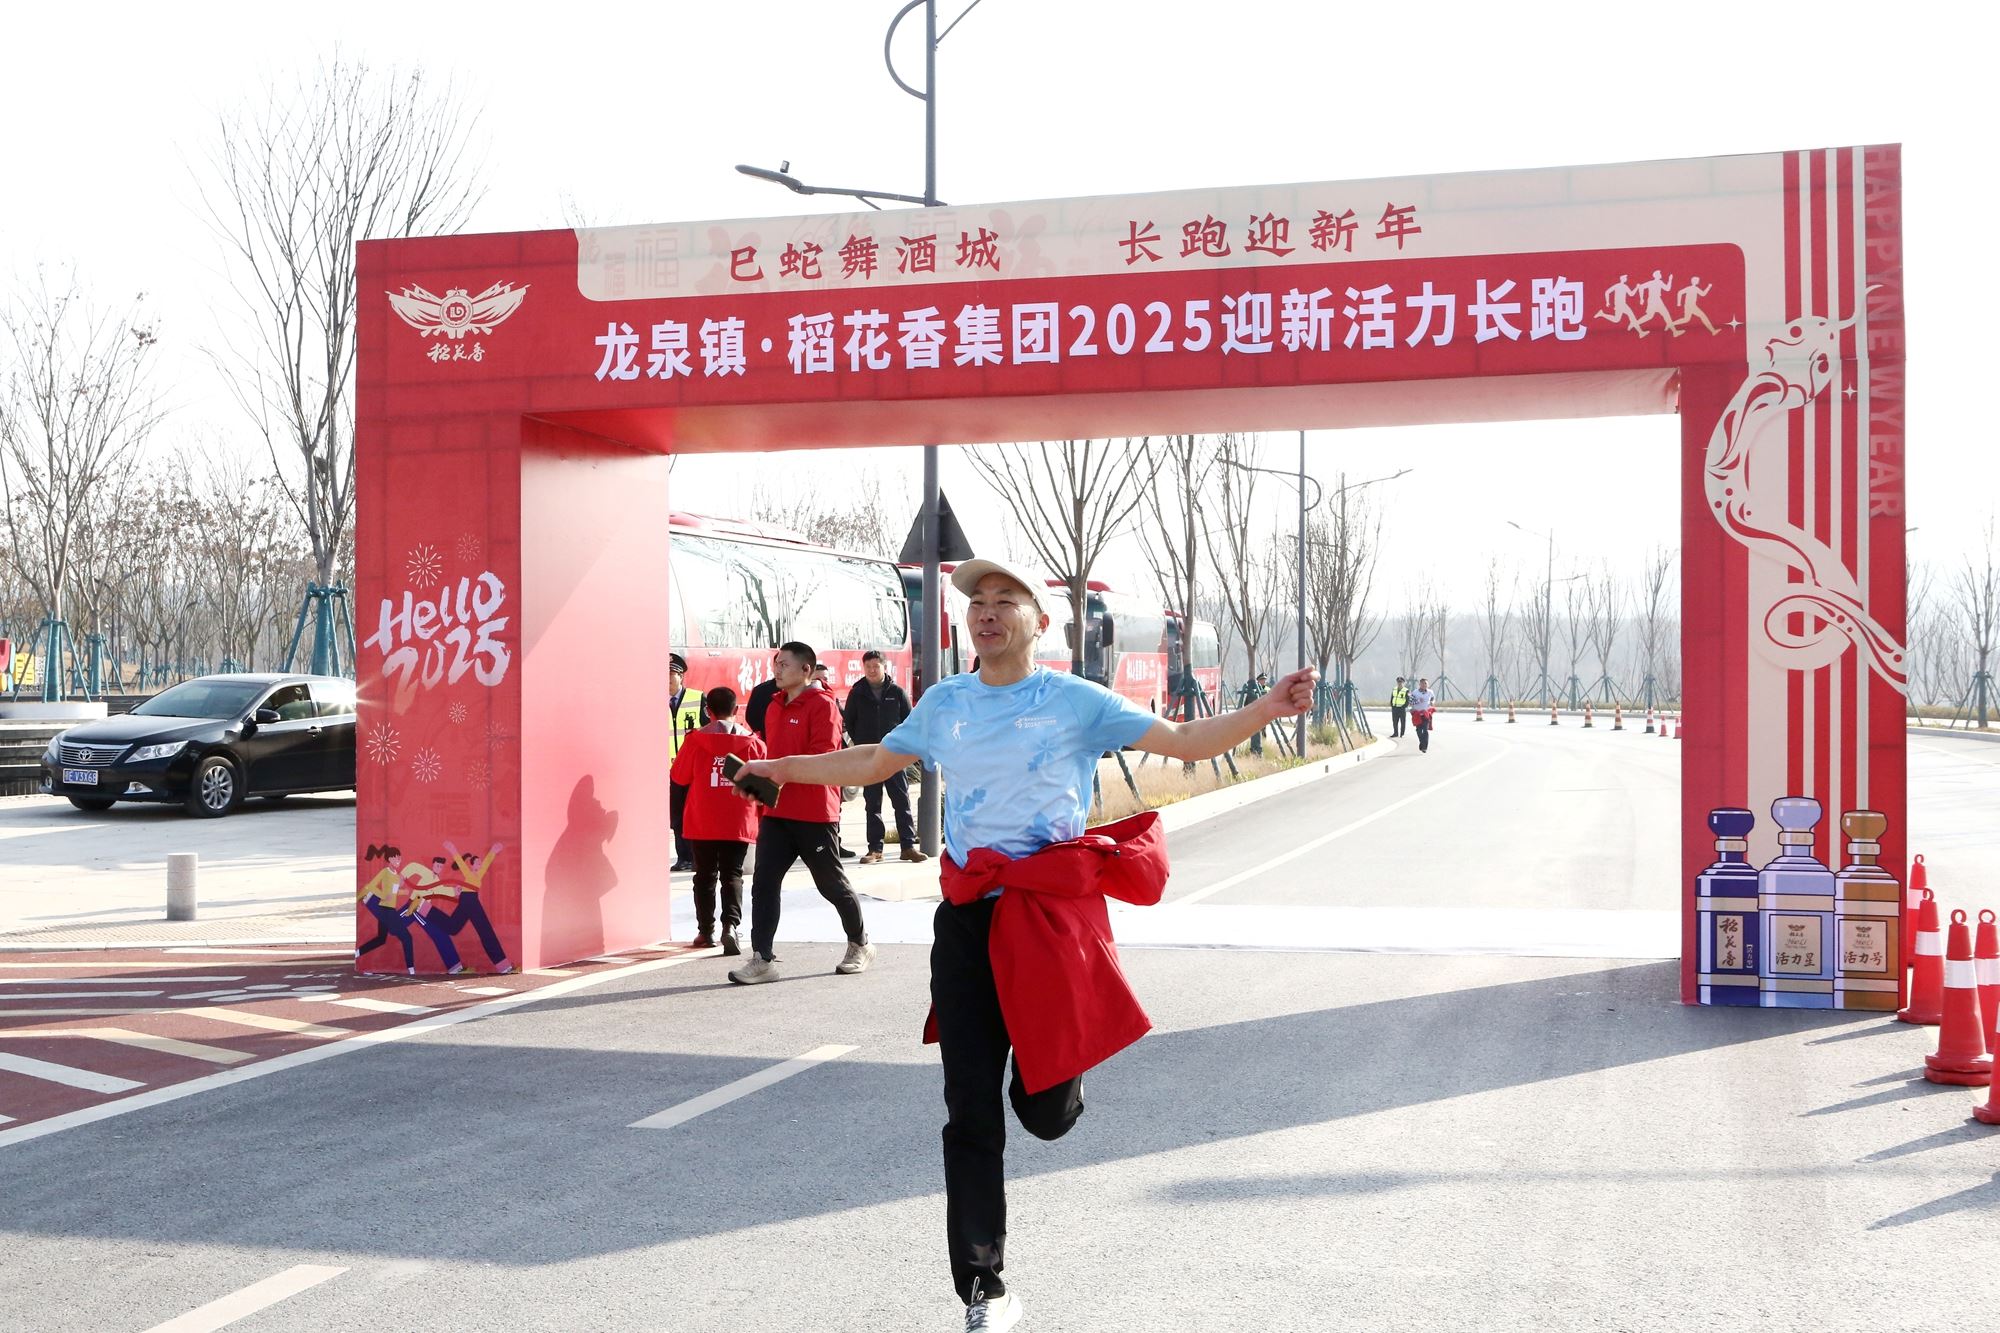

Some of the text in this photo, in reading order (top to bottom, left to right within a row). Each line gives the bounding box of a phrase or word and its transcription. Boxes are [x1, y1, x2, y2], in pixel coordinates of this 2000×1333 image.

[730, 228, 1001, 281] 巳蛇舞酒城
[1119, 202, 1423, 265] 长跑迎新年
[427, 342, 486, 363] 稻花香
[364, 571, 506, 653] Hello
[382, 617, 512, 716] 2025
